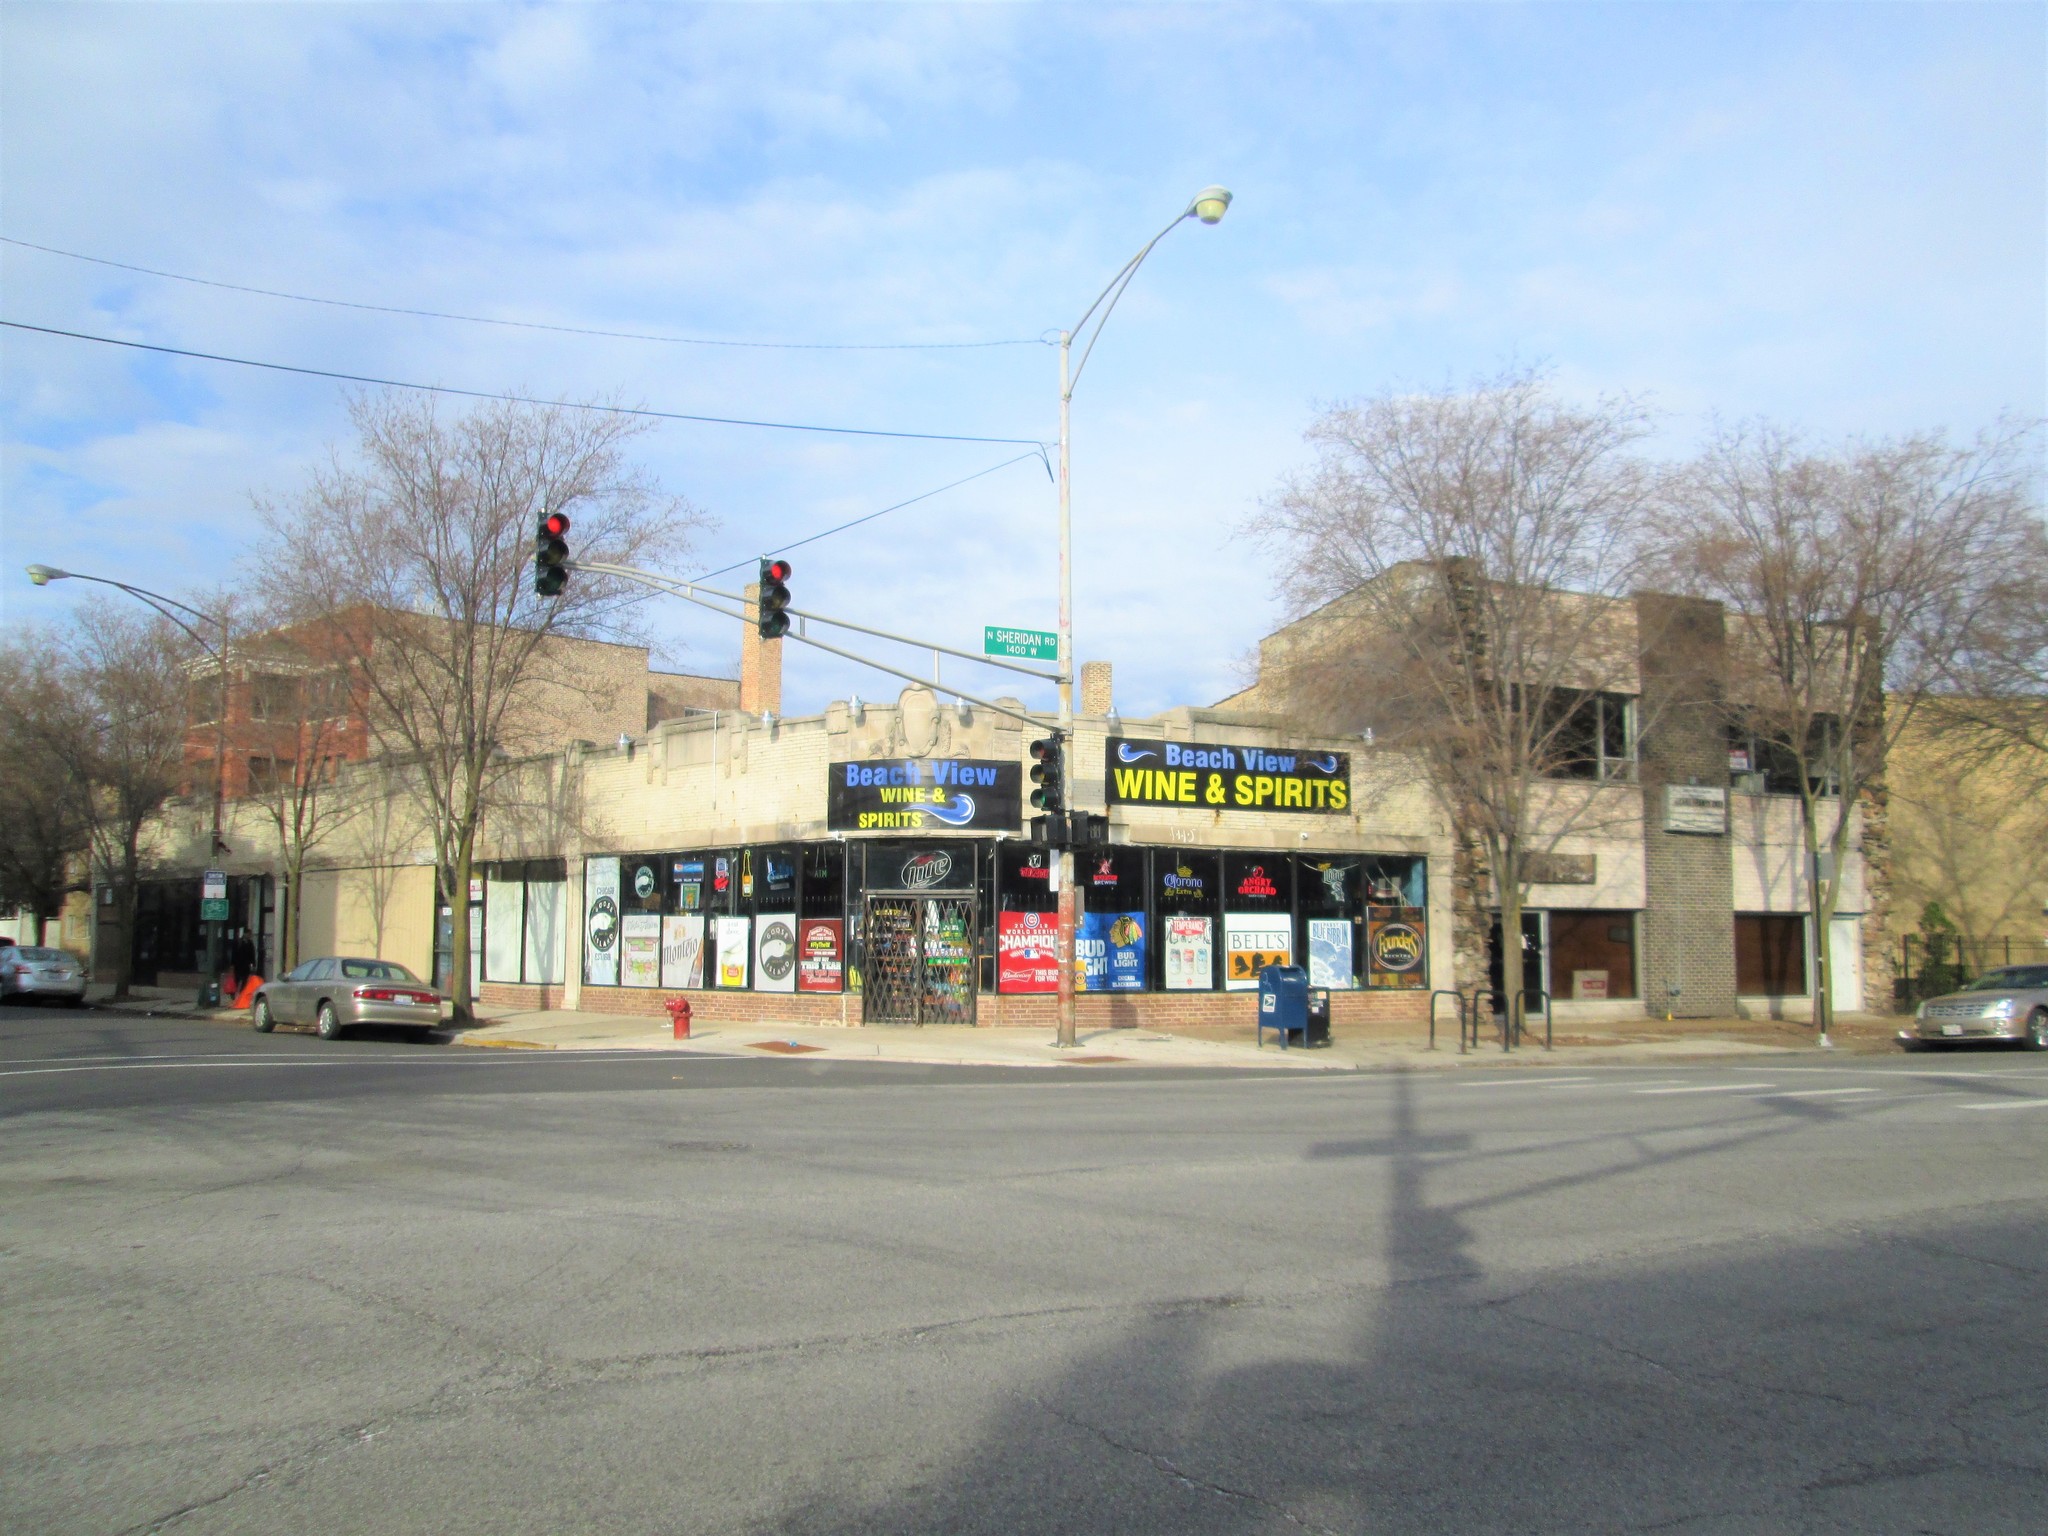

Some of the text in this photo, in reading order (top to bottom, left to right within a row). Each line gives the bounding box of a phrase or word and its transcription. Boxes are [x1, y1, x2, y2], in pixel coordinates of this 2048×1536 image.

[987, 630, 1056, 646] N SHERIDAN RD
[1006, 644, 1037, 656] 1400 W
[1165, 743, 1296, 773] Beach View
[846, 761, 997, 787] Beach View
[880, 788, 946, 803] WINE &
[1114, 768, 1347, 810] WINE & SPIRITS
[859, 812, 923, 829] SPIRITS
[1164, 874, 1203, 888] Corona
[1244, 877, 1272, 886] ANGRY
[1238, 885, 1277, 896] ORCHARD
[766, 926, 789, 940] GOOSE
[594, 934, 614, 948] ISLAND
[1076, 940, 1106, 956] BUD
[1380, 932, 1418, 958] Founders
[766, 961, 790, 976] ISLAND
[1114, 960, 1138, 968] LIGHT
